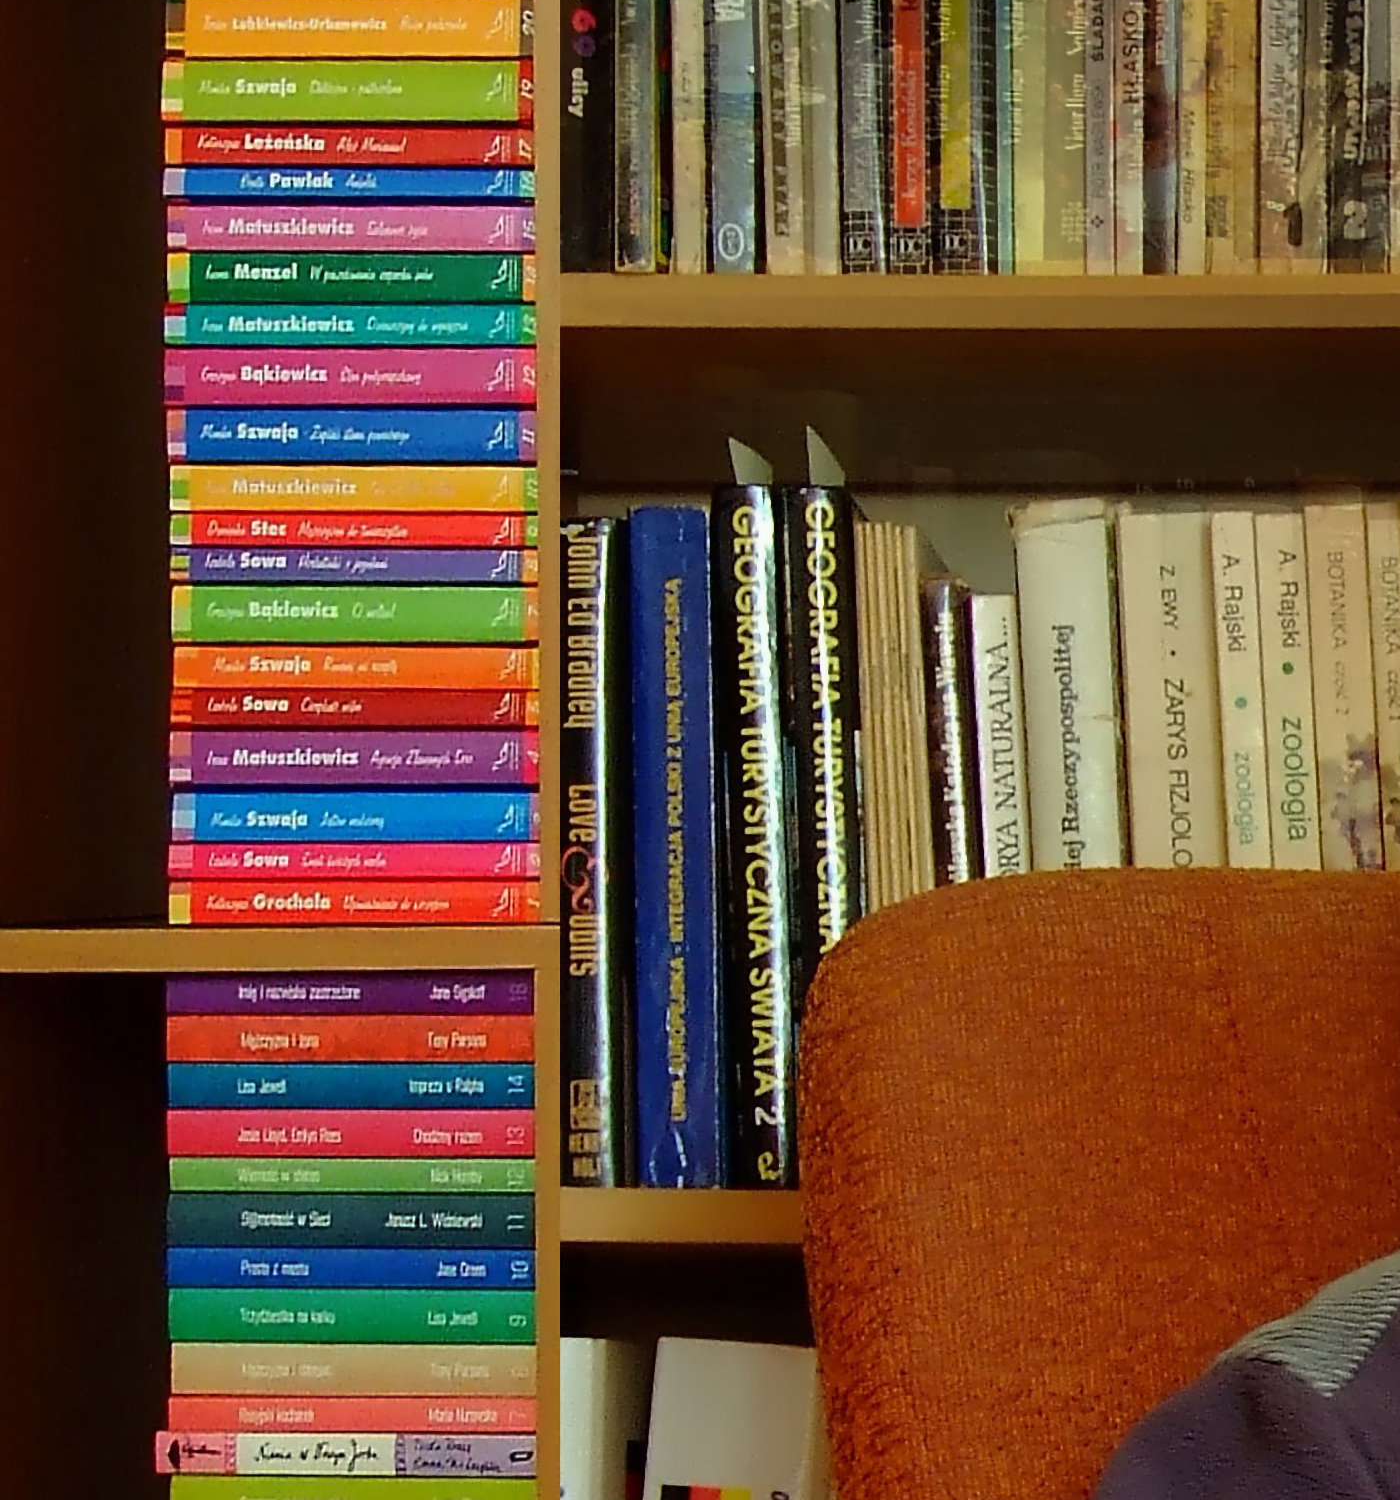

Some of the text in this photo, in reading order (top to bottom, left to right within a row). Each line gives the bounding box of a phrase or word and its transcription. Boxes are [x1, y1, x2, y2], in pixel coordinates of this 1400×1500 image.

[728, 504, 772, 717] GEOGRAFIA
[1278, 549, 1309, 842] A. Rajski zoologia
[739, 726, 774, 961] TURYSTYCZNA
[755, 1108, 772, 1126] 2
